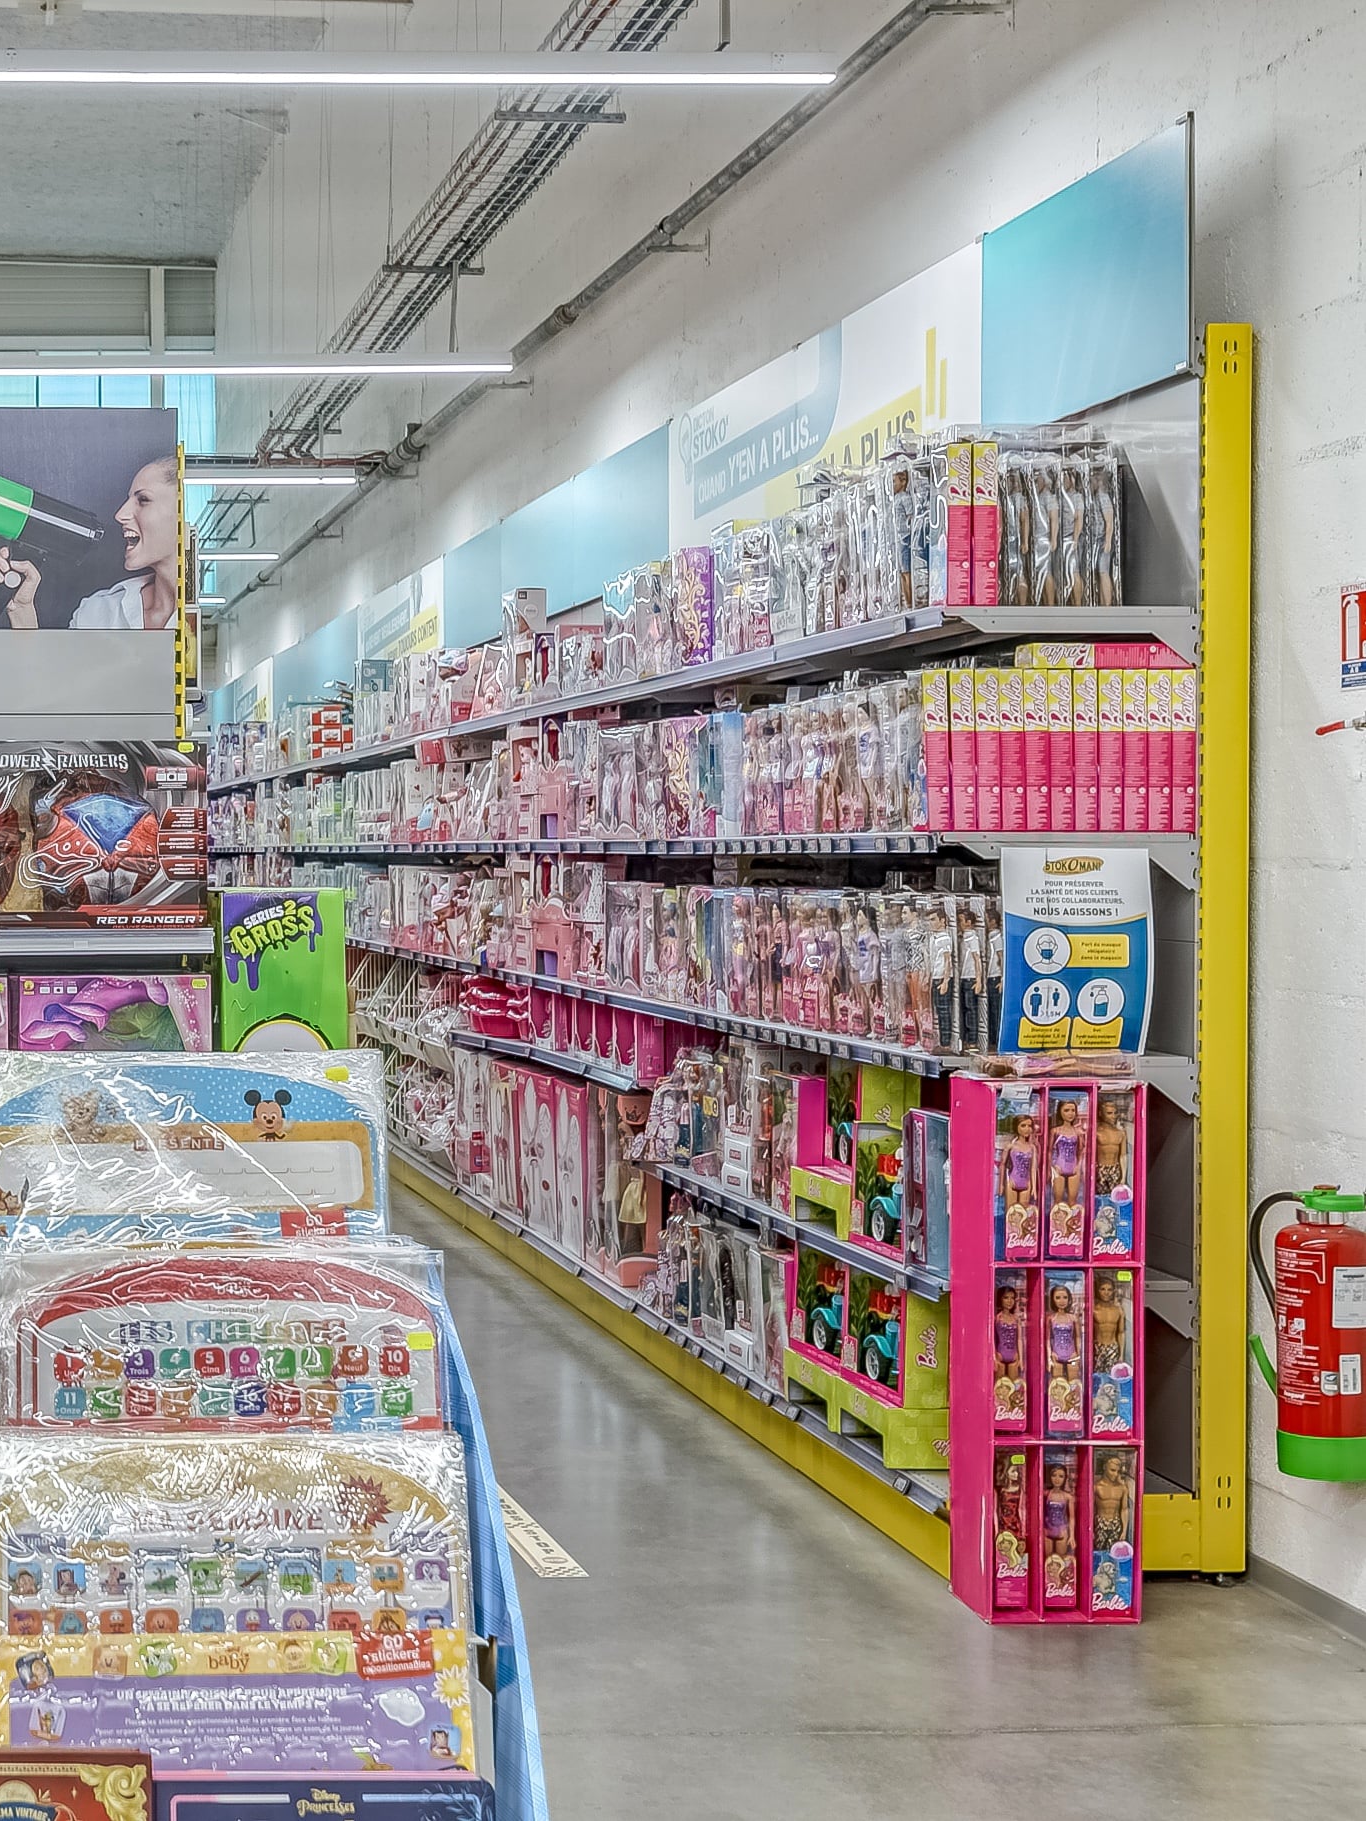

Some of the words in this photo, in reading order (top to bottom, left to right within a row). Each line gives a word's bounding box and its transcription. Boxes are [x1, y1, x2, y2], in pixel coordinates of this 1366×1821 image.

[698, 470, 726, 504] QUAND
[758, 441, 769, 472] A
[57, 753, 128, 772] RANGERS
[243, 905, 284, 929] SERIES
[283, 900, 296, 916] 2
[1034, 907, 1060, 917] NOUS
[1062, 907, 1112, 917] AGISSONS
[96, 915, 130, 925] RED
[133, 915, 196, 925] RANGER
[230, 905, 315, 960] GROSS
[1007, 1233, 1036, 1249] Barbie
[1051, 1230, 1082, 1246] Barbie
[1092, 1237, 1128, 1255] Barbie
[916, 1323, 938, 1369] Barbie
[134, 1352, 144, 1366] 3
[206, 1352, 214, 1365] 5
[240, 1351, 250, 1364] 6
[386, 1350, 403, 1363] 10
[129, 1368, 149, 1376] Trois
[201, 1366, 220, 1375] Cinq
[63, 1392, 77, 1406] 11
[995, 1406, 1025, 1421] Barbie
[1050, 1406, 1081, 1421] Barbie
[1092, 1415, 1129, 1433] Barbie
[997, 1563, 1027, 1578] Barbie
[1046, 1583, 1075, 1598] Barbie
[1092, 1593, 1128, 1611] Barbie
[208, 1650, 251, 1672] baby
[370, 1649, 420, 1660] stickers
